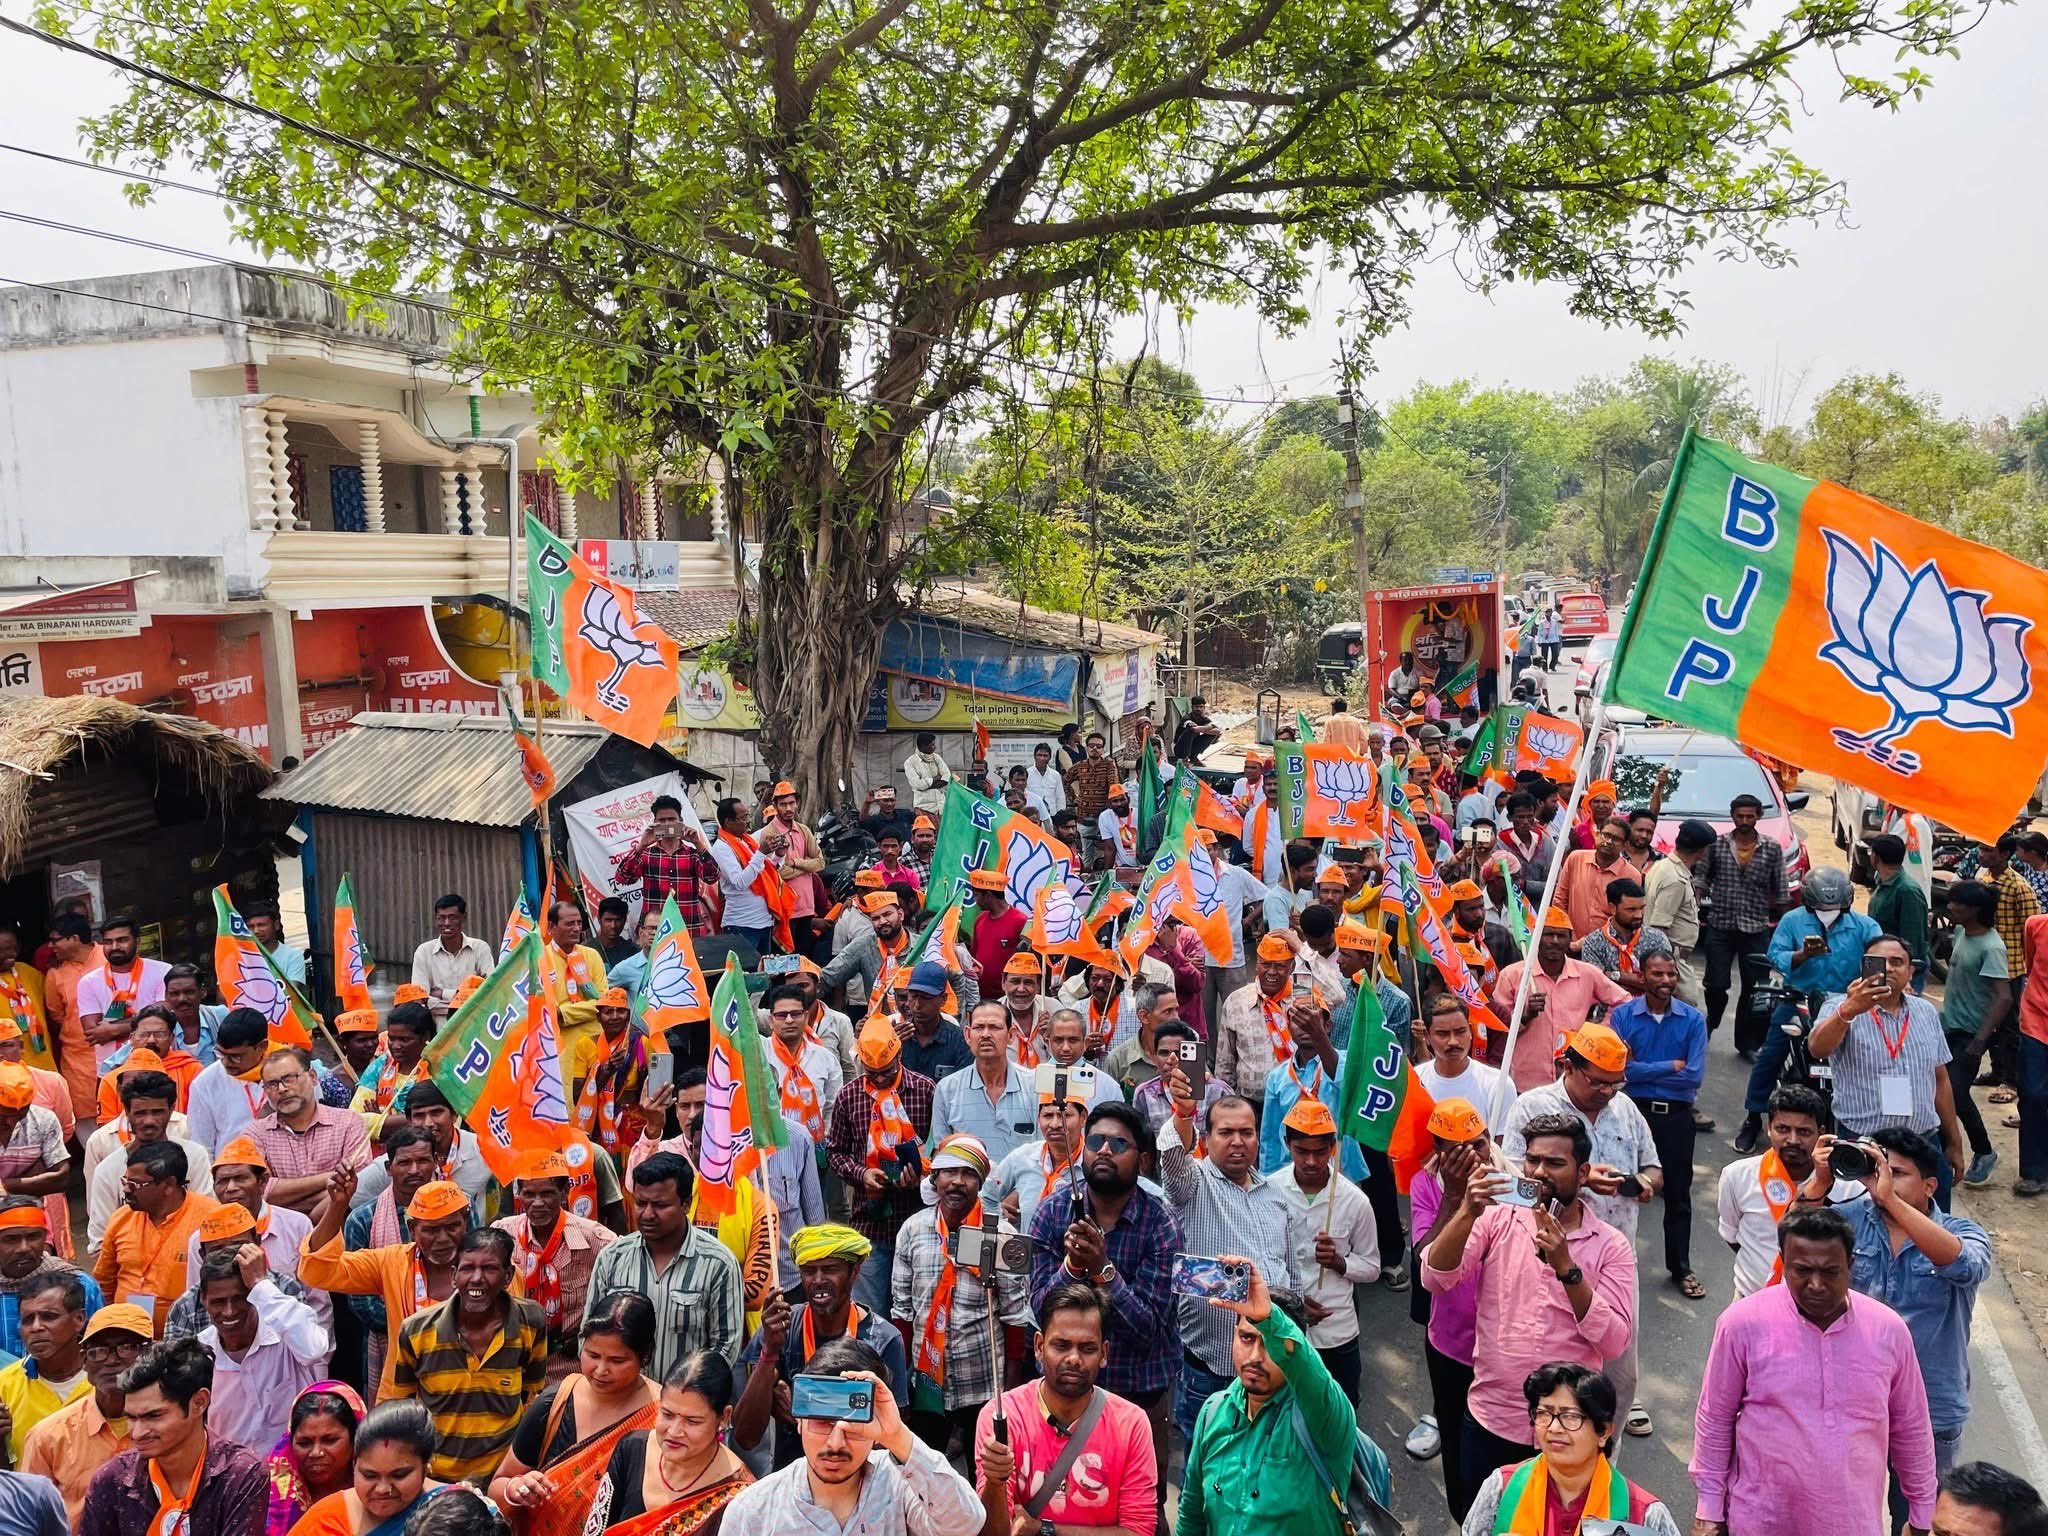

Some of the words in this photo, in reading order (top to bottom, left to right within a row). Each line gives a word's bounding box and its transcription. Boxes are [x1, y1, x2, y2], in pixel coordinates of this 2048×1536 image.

[1665, 473, 1779, 702] BJP
[20, 621, 35, 631] MA
[37, 619, 81, 630] BINAPANI
[82, 618, 133, 628] HARDWARE
[177, 671, 209, 686] দেশের
[191, 675, 253, 704] ভরসা
[400, 669, 450, 691] ভরসা
[963, 704, 986, 713] Total
[989, 704, 1018, 715] piping
[1503, 713, 1522, 765] BJP
[1286, 755, 1304, 828] BJP
[1130, 850, 1177, 924] BJP
[1358, 1043, 1402, 1122] JP
[568, 1173, 590, 1189] BJP
[744, 1213, 778, 1300] CHAMPIO
